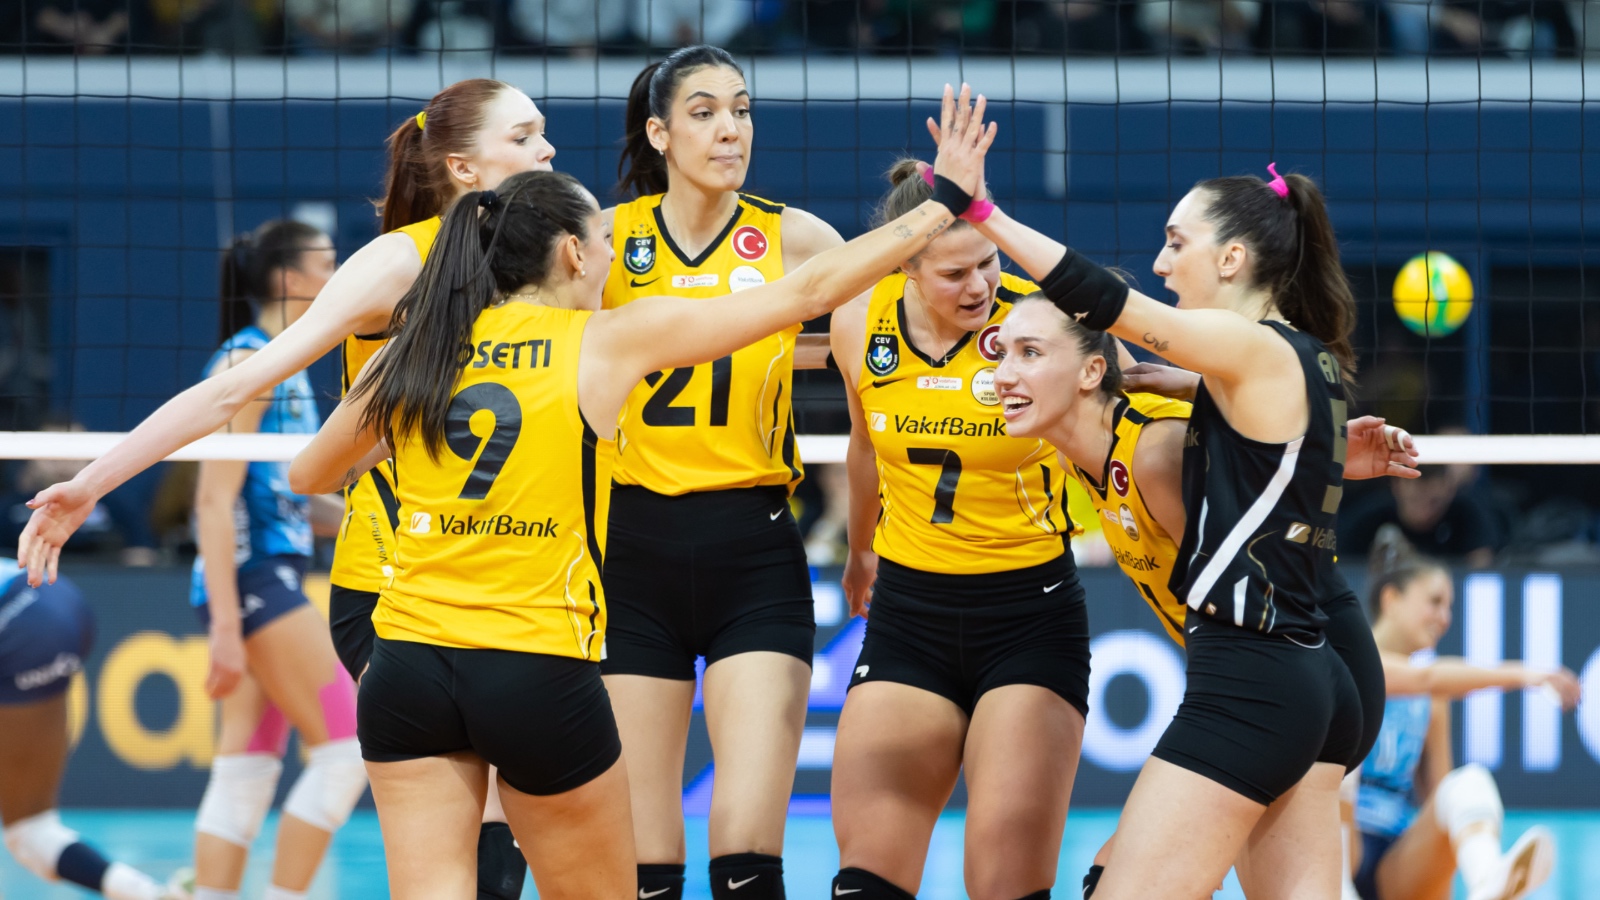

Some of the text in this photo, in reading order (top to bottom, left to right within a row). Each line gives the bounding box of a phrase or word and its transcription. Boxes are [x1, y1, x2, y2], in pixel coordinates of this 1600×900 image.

[635, 238, 652, 246] CEV
[457, 339, 552, 369] OSETTI
[875, 336, 891, 344] CEV
[642, 353, 732, 427] 21
[444, 381, 522, 500] 9
[906, 447, 962, 524] 7
